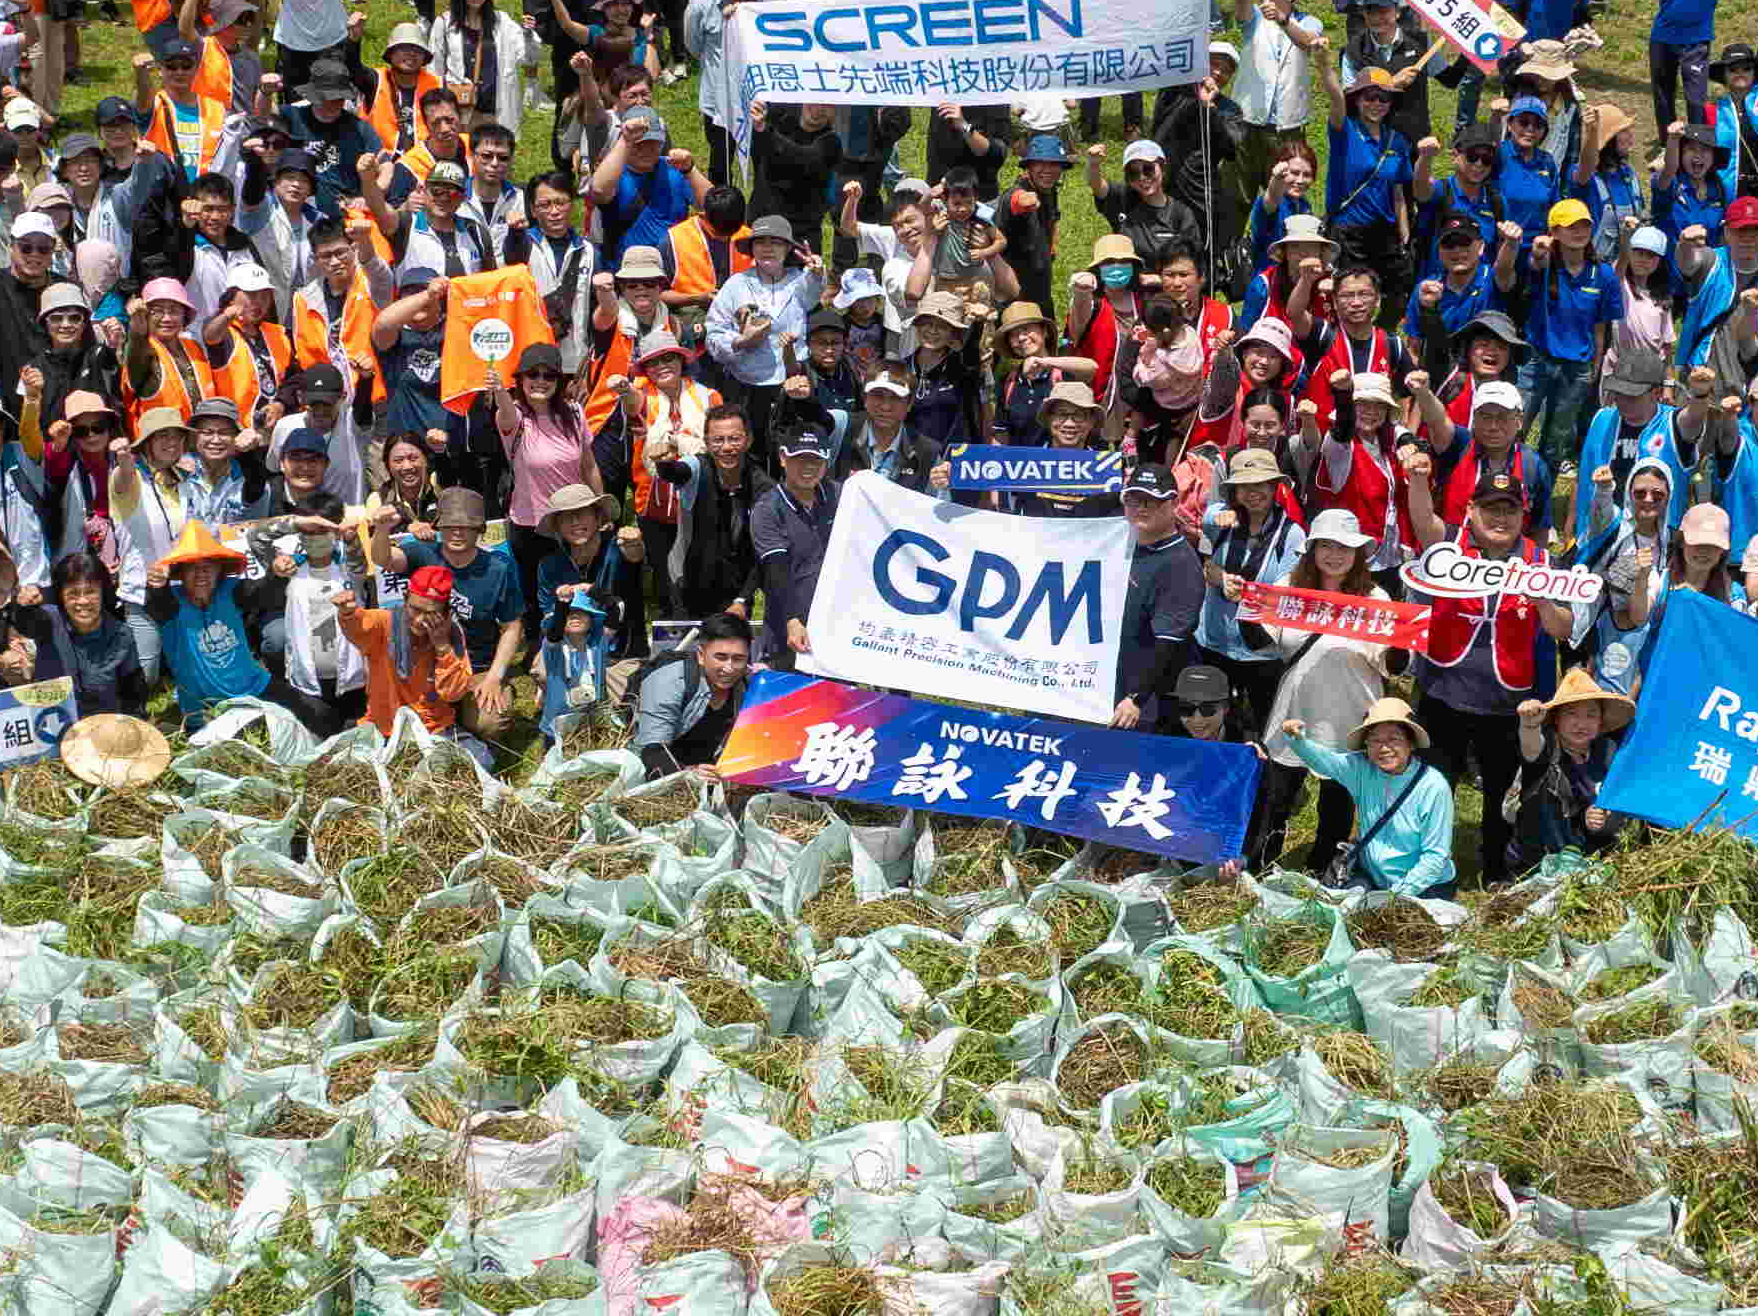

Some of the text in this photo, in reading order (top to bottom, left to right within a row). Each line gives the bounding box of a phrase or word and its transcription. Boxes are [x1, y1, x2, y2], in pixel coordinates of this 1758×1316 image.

[960, 460, 1093, 480] NOVATEK
[872, 528, 1104, 646] GPM
[1424, 547, 1597, 598] Coretronic
[850, 637, 899, 656] Gallant
[903, 644, 964, 669] Precision
[940, 720, 1063, 757] NOVATEK
[790, 721, 1177, 841] 聯詠科技
